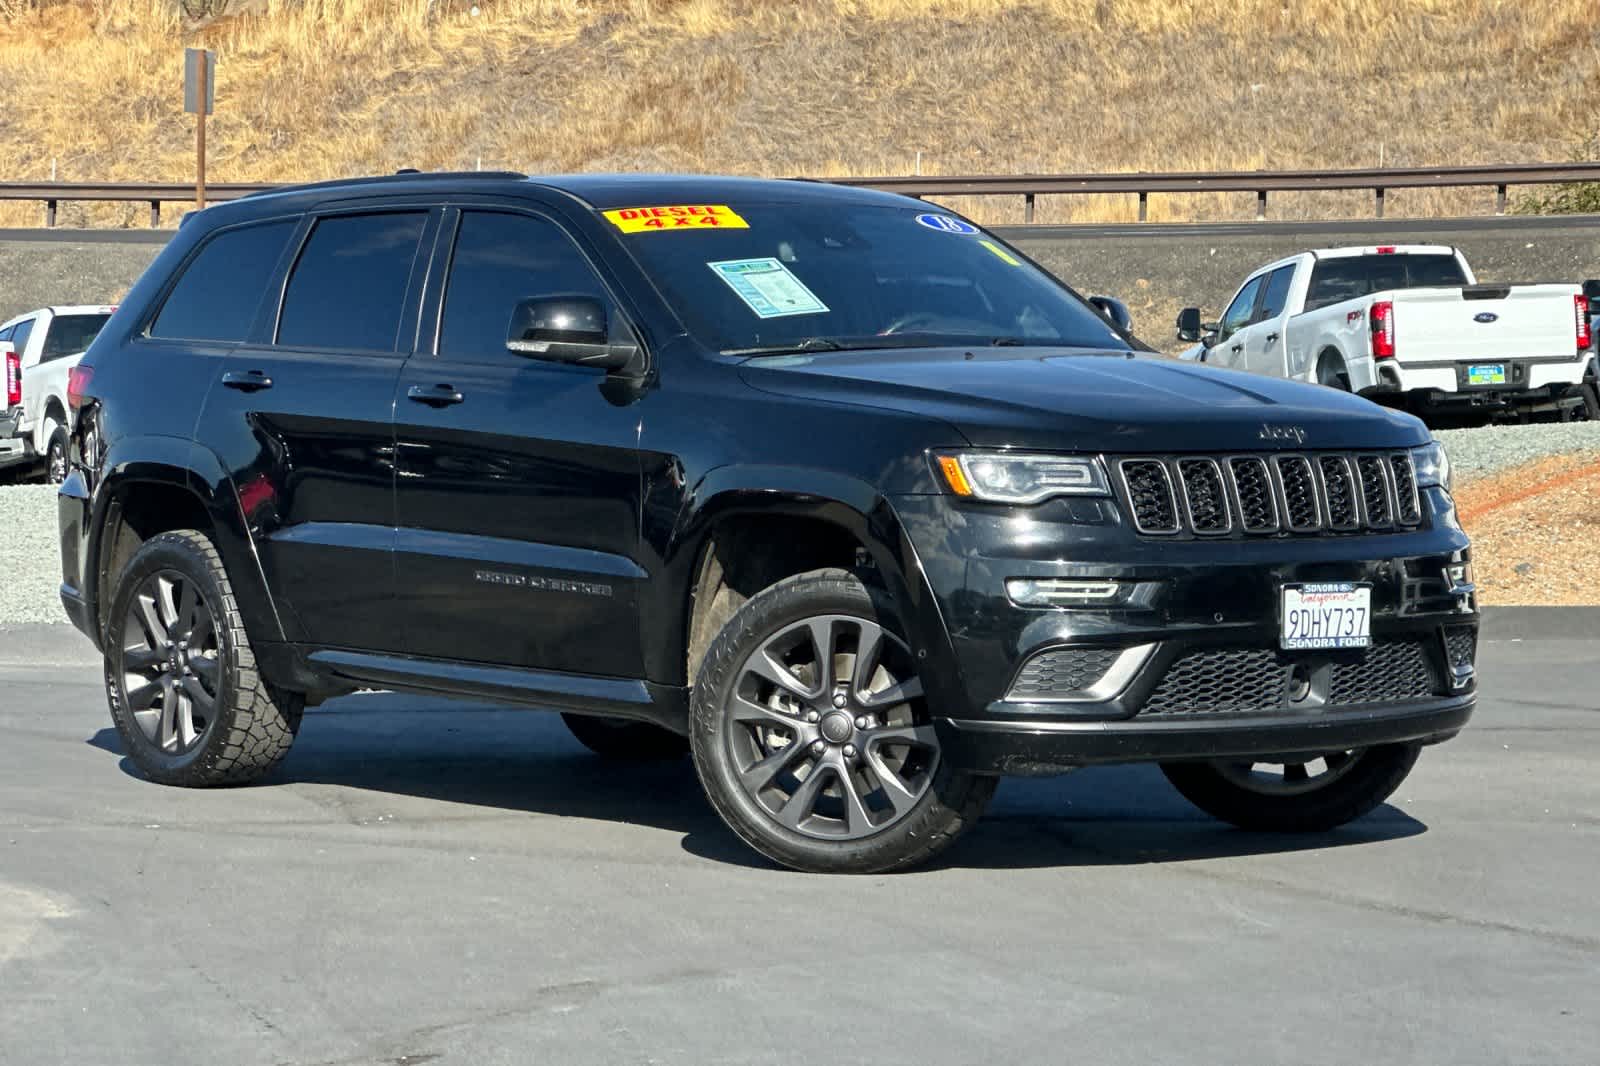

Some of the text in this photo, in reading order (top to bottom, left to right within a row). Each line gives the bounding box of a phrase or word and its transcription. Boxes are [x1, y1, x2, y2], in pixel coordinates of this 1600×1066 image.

[619, 207, 724, 220] DIESEL
[1305, 584, 1338, 592] SONORA
[1289, 608, 1366, 638] 9DHY737
[1289, 637, 1368, 648] SONORA FORD
